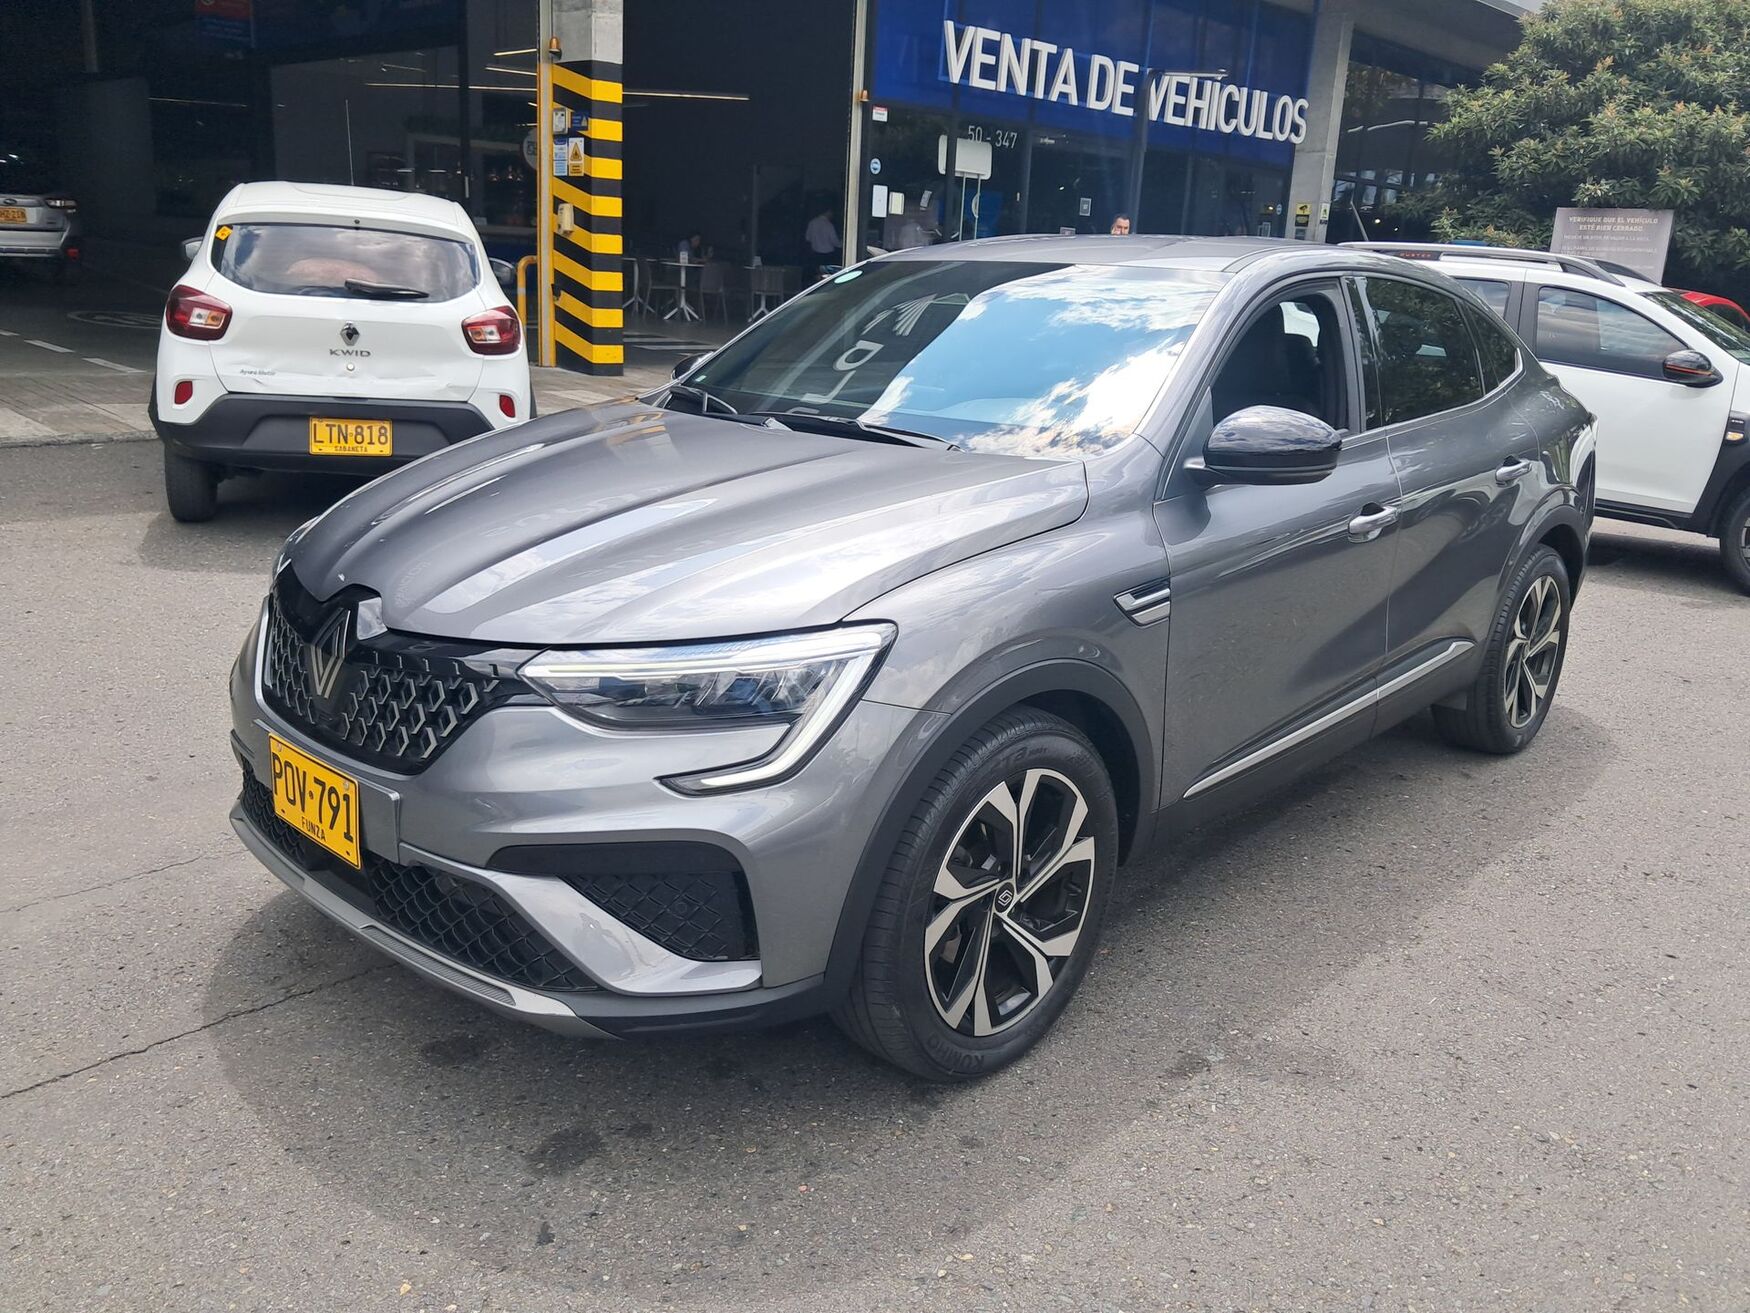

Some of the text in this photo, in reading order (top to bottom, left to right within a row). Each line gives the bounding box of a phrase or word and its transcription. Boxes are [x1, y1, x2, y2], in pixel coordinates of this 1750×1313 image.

[944, 20, 1078, 106] VENTA
[1086, 54, 1140, 117] DE
[968, 125, 983, 144] 50
[995, 130, 1018, 149] 347
[329, 348, 372, 358] KWID
[334, 445, 368, 453] SABANETA
[301, 816, 327, 842] FUNZA
